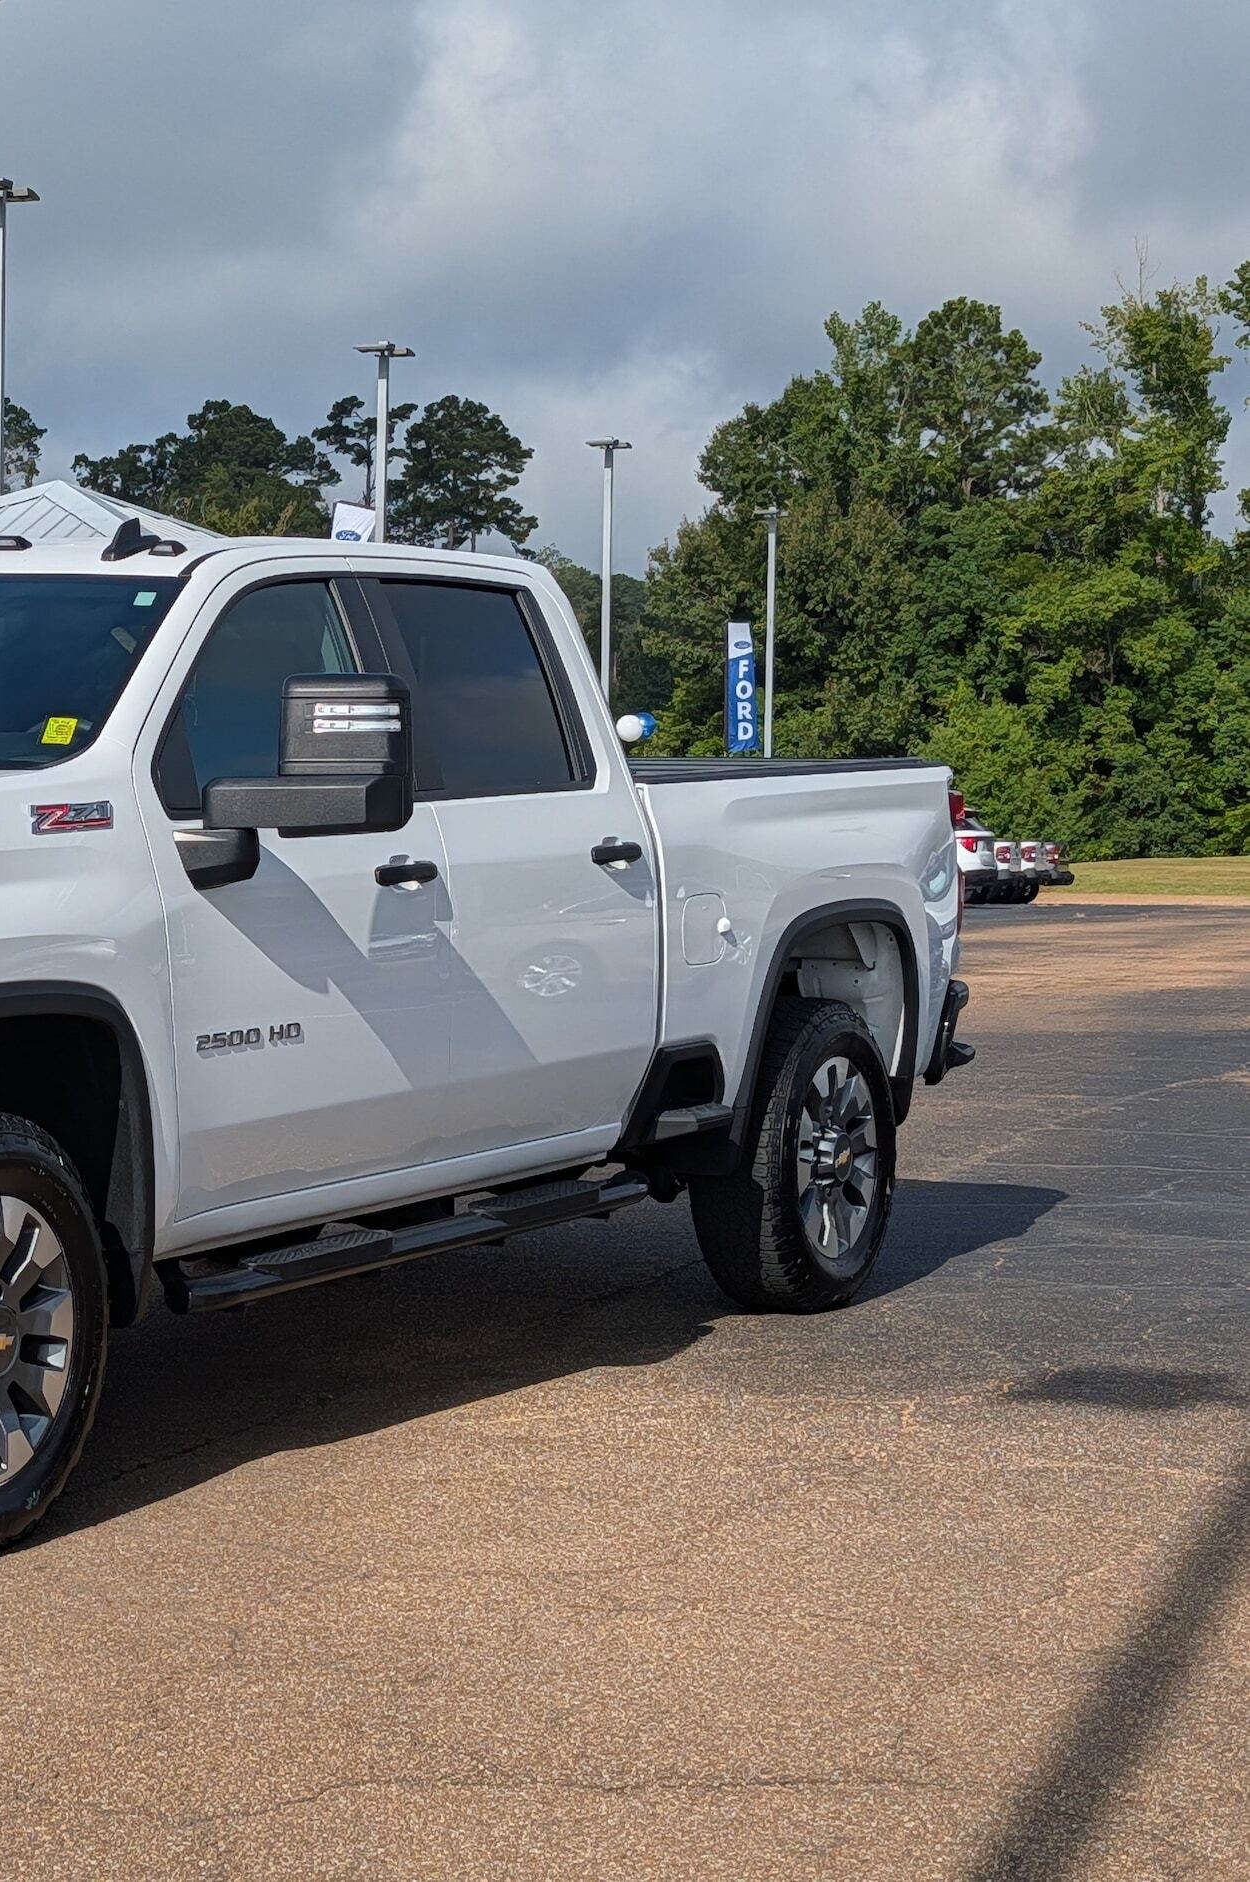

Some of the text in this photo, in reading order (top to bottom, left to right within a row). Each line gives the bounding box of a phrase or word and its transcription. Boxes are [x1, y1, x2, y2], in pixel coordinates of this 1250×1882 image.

[735, 660, 754, 741] FORD
[31, 801, 113, 835] Z71
[196, 1022, 301, 1053] 2500 HD
